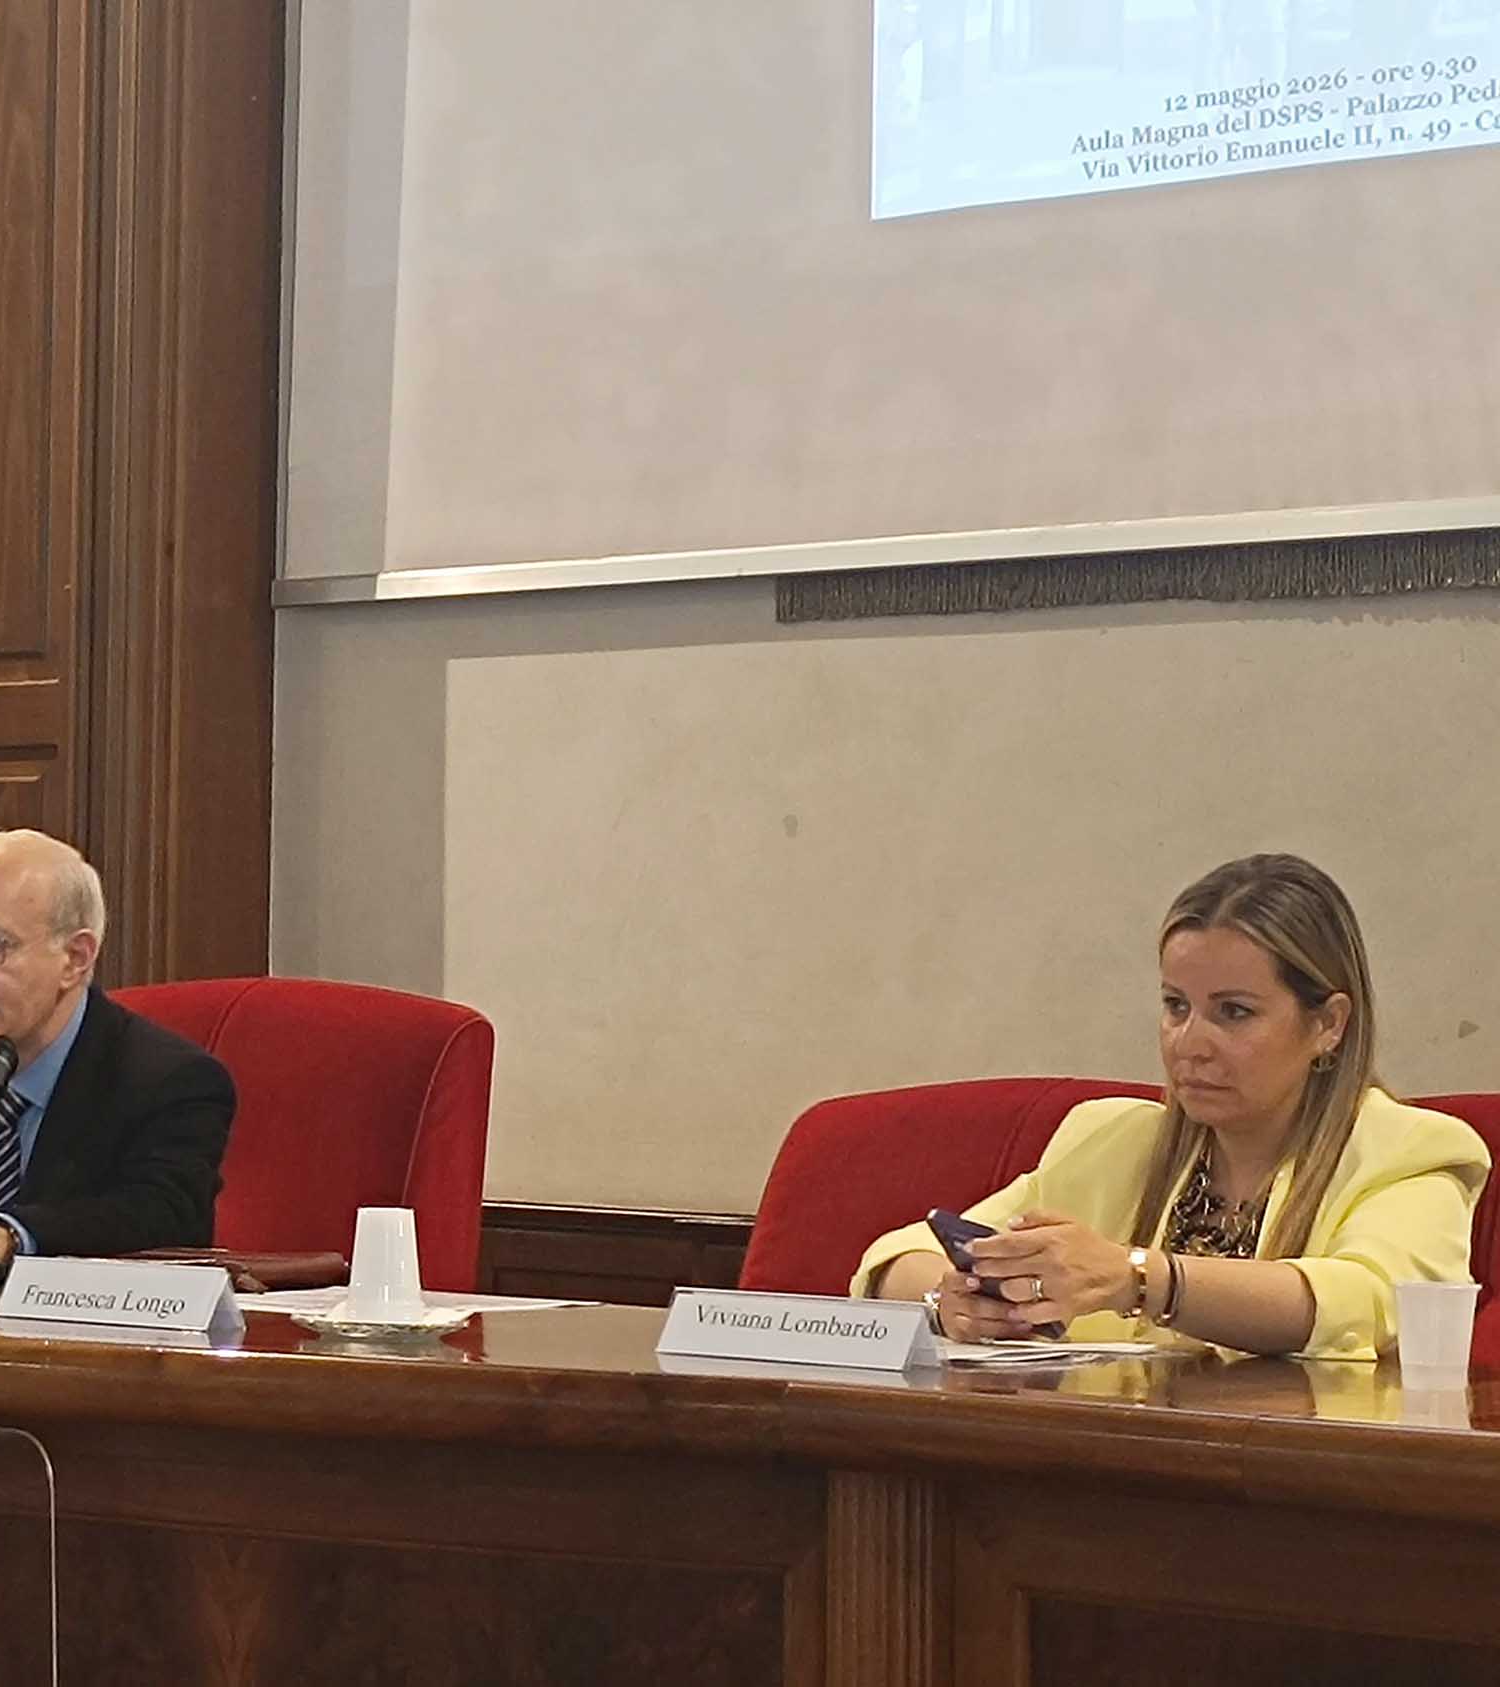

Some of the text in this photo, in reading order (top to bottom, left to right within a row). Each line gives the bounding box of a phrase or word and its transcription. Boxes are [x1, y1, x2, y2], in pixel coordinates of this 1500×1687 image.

[1164, 94, 1188, 112] 12
[1195, 77, 1280, 109] maggio
[1287, 67, 1348, 95] 2026
[1371, 65, 1414, 84] ore
[1421, 55, 1477, 83] 9.30
[1071, 130, 1124, 154] Aula
[1132, 122, 1208, 148] Magna
[1216, 111, 1250, 135] del
[1259, 101, 1323, 129] DSPS
[1347, 92, 1443, 118] Palazzo
[1450, 79, 1500, 105] Ped
[1082, 160, 1119, 181] Via
[1127, 147, 1219, 175] Vittorio
[1226, 128, 1346, 162] Emanuele
[1352, 123, 1382, 149] II,
[1389, 125, 1412, 142] n.
[1421, 119, 1451, 143] 49
[21, 1284, 185, 1319] Francesca Longo
[697, 1304, 888, 1341] Viviana Lombardo
